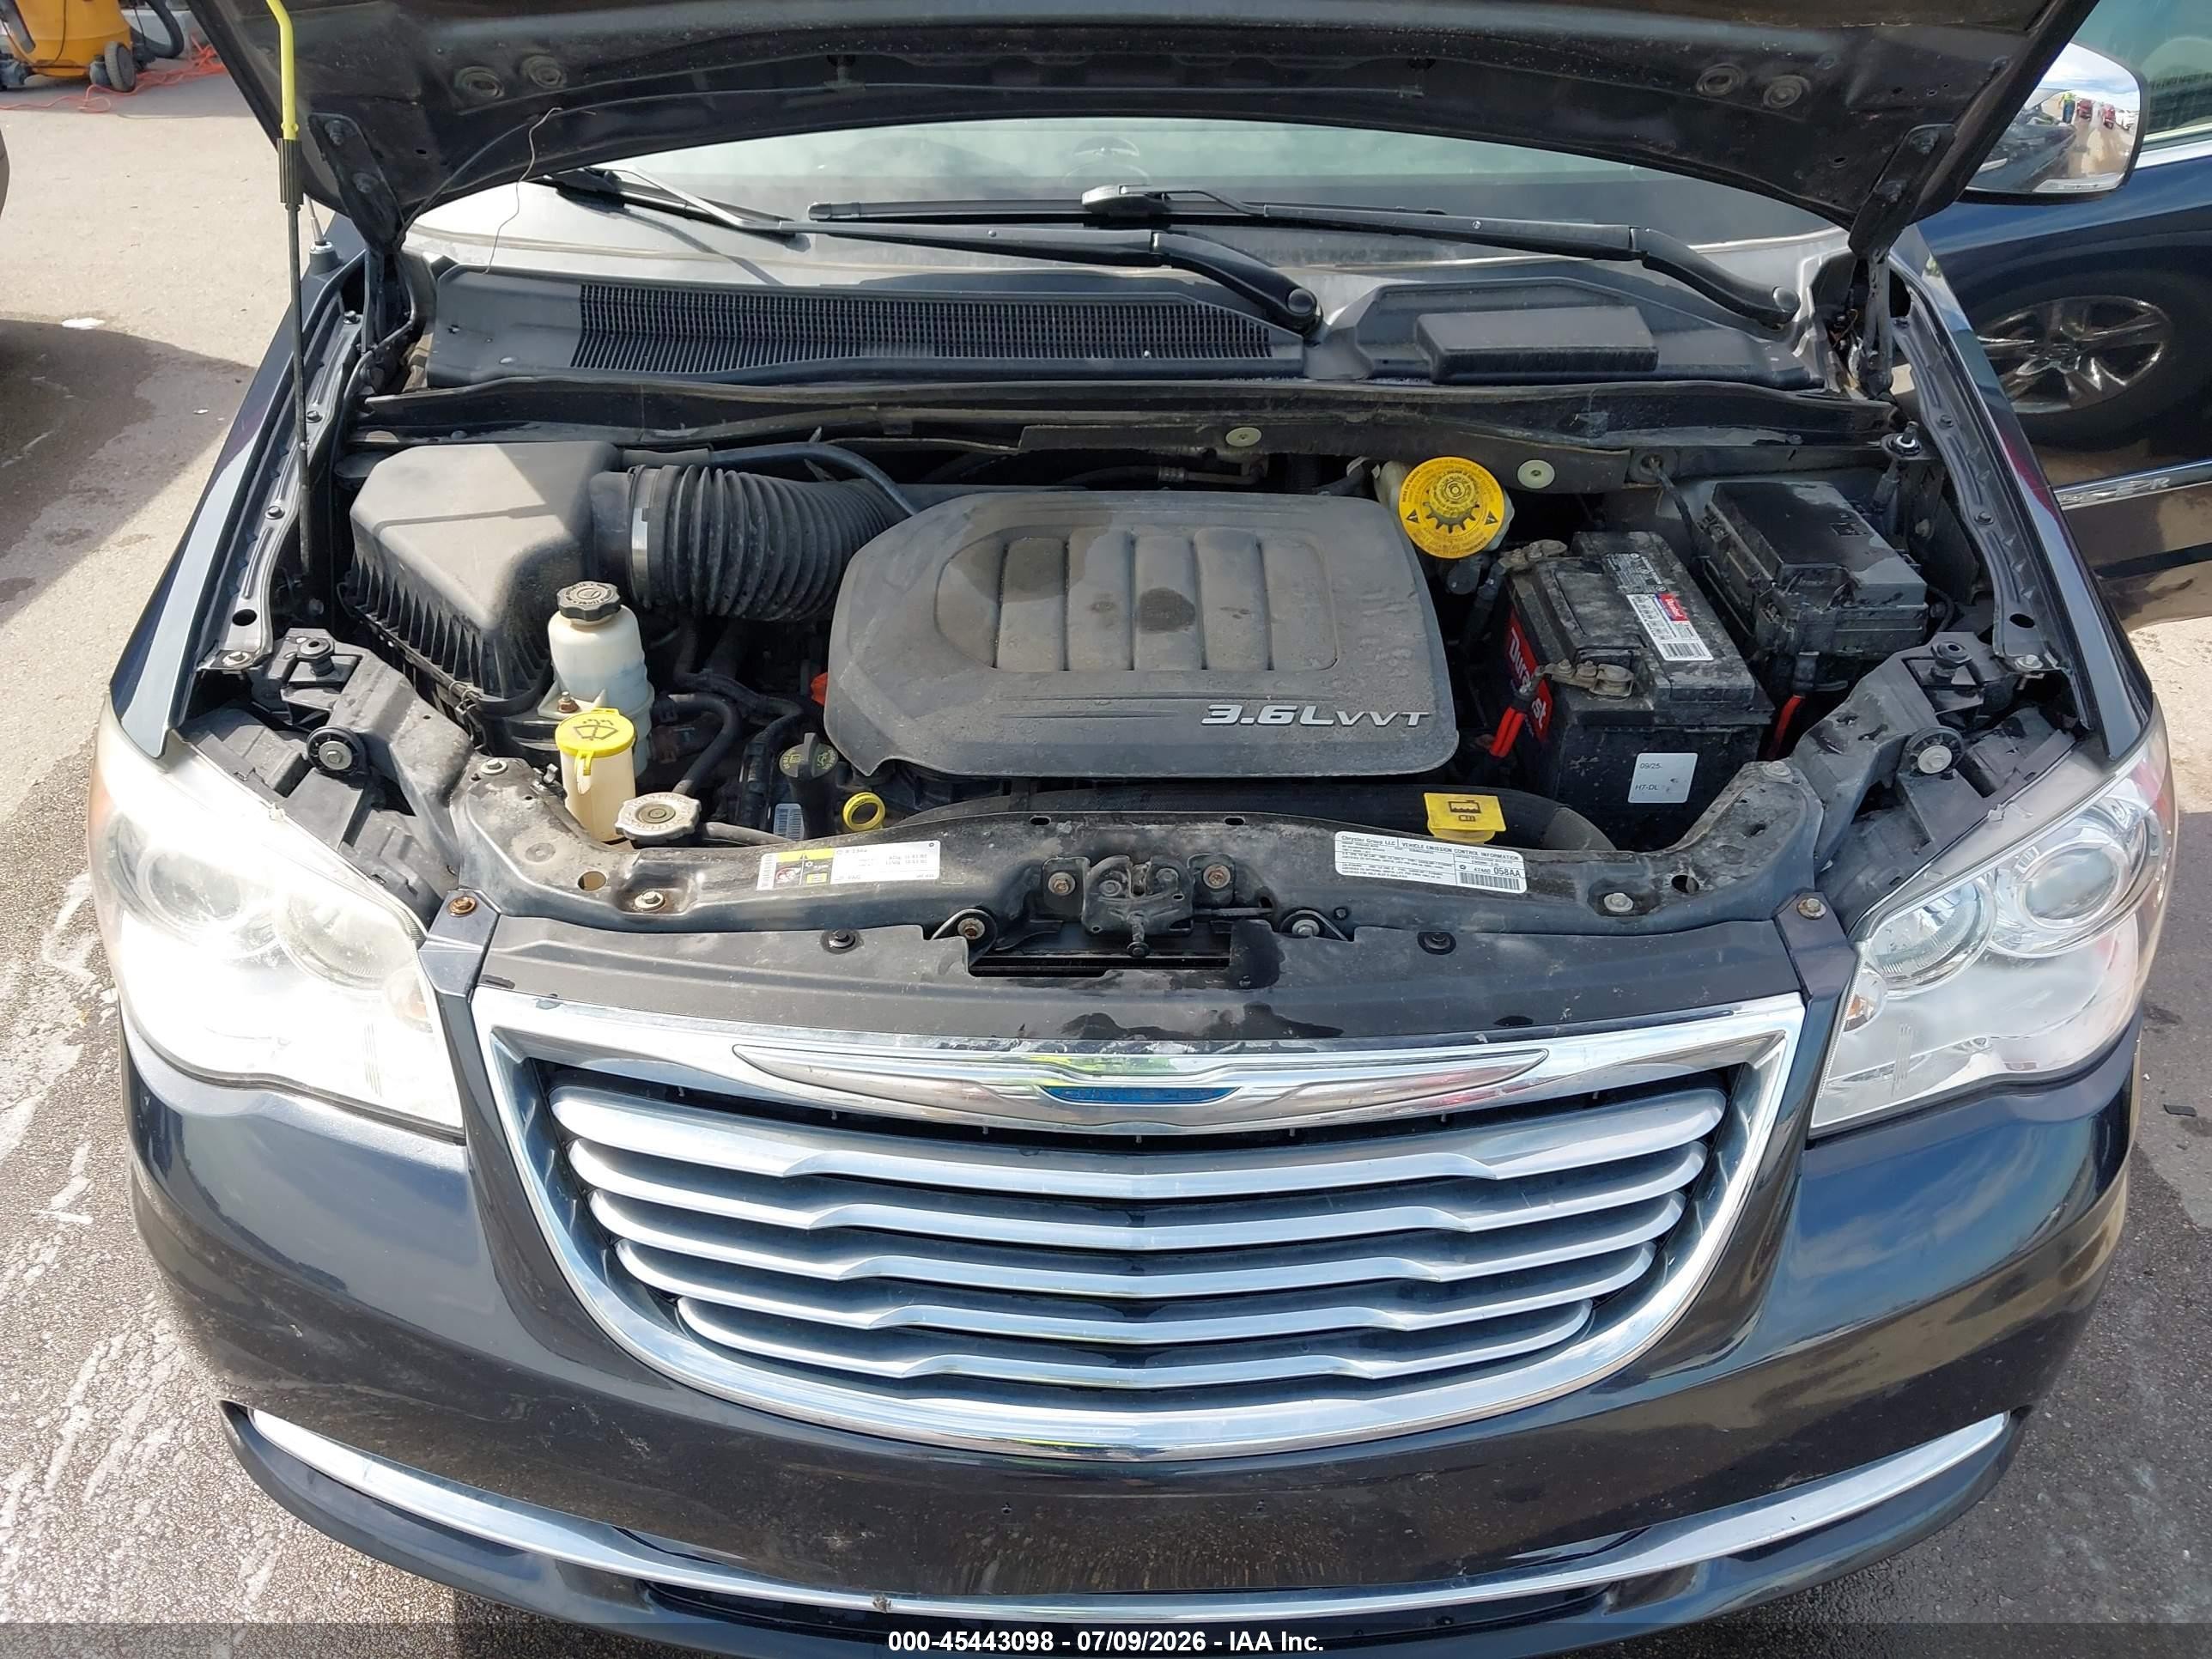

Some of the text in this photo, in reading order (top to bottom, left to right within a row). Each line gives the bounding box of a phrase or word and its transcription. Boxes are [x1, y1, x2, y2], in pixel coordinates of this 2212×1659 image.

[1509, 626, 1547, 730] Durast
[1201, 704, 1431, 728] 3.6L VVT
[1480, 852, 1520, 860] INFORMATION
[1493, 866, 1522, 878] 058AA
